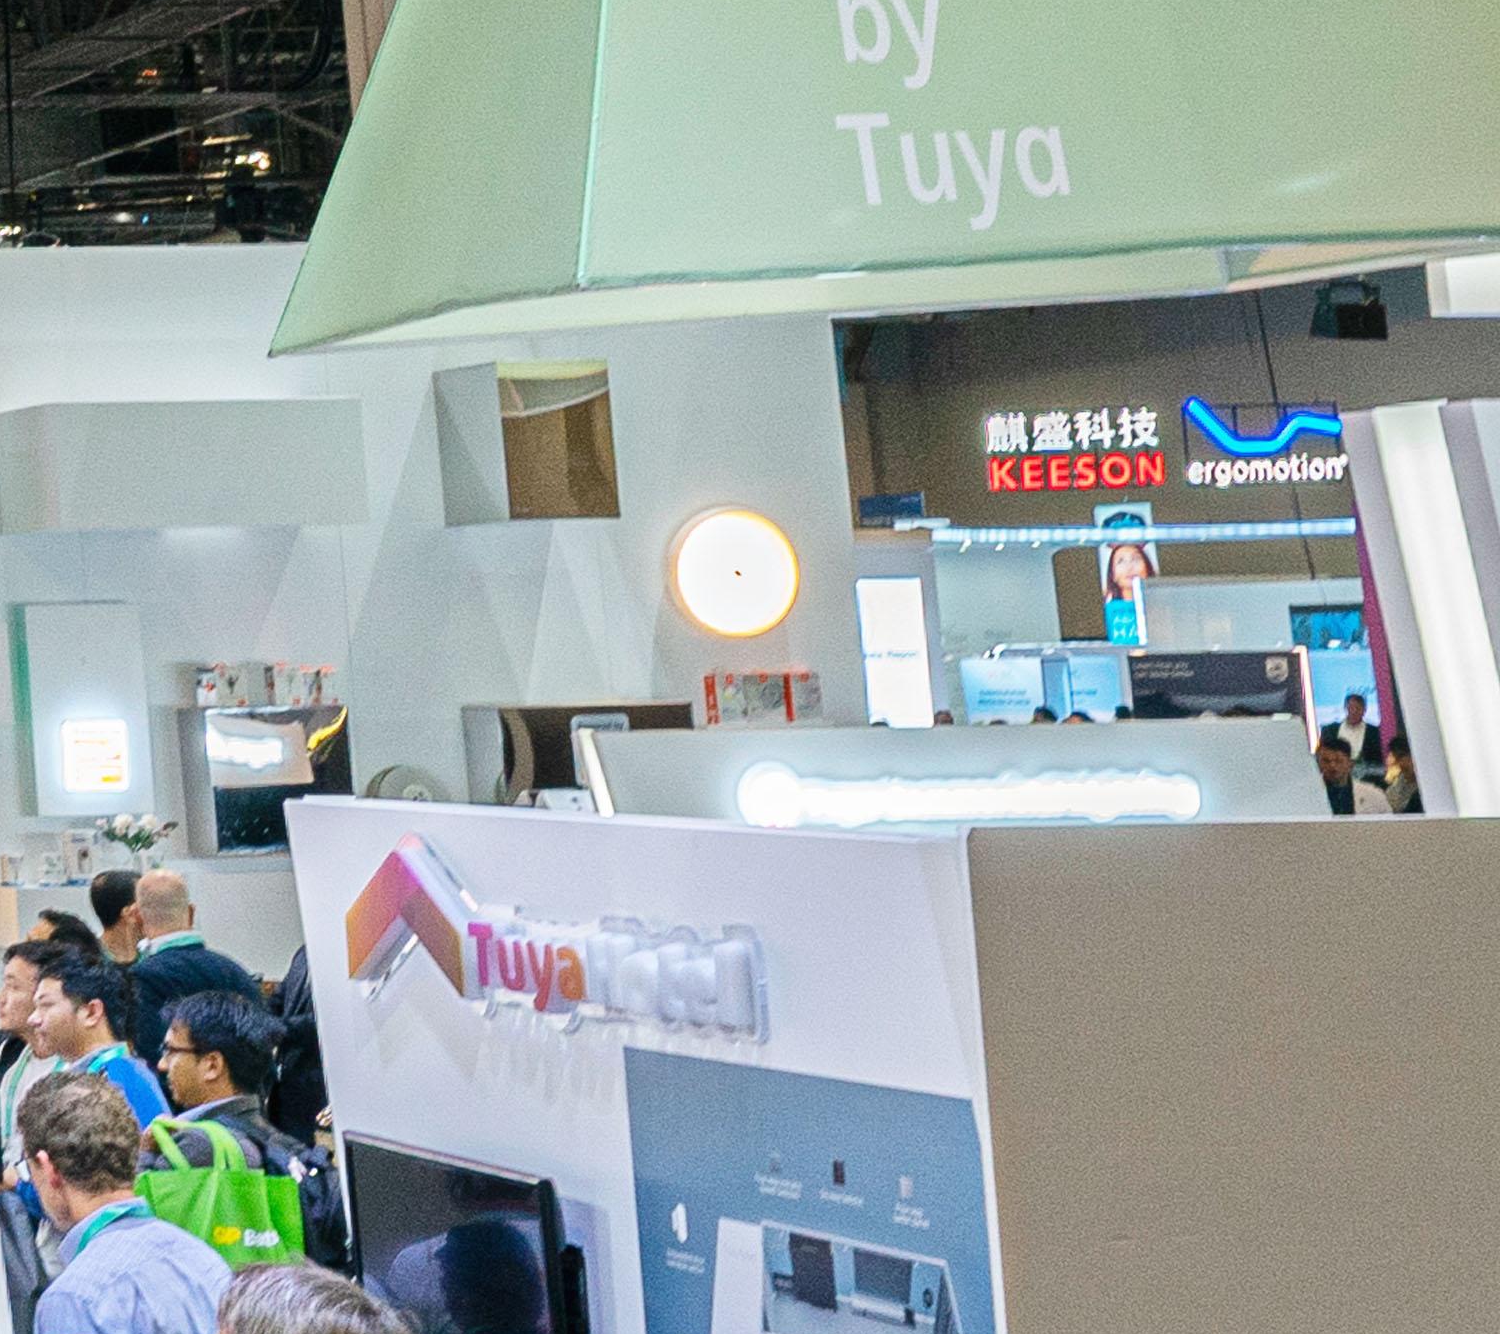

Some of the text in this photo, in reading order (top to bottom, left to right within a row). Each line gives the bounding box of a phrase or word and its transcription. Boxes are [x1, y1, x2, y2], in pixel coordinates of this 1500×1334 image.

[836, 113, 1071, 231] Tuya
[989, 452, 1165, 492] KEESON
[1187, 454, 1346, 488] ergomotion
[467, 922, 586, 1012] Tuya
